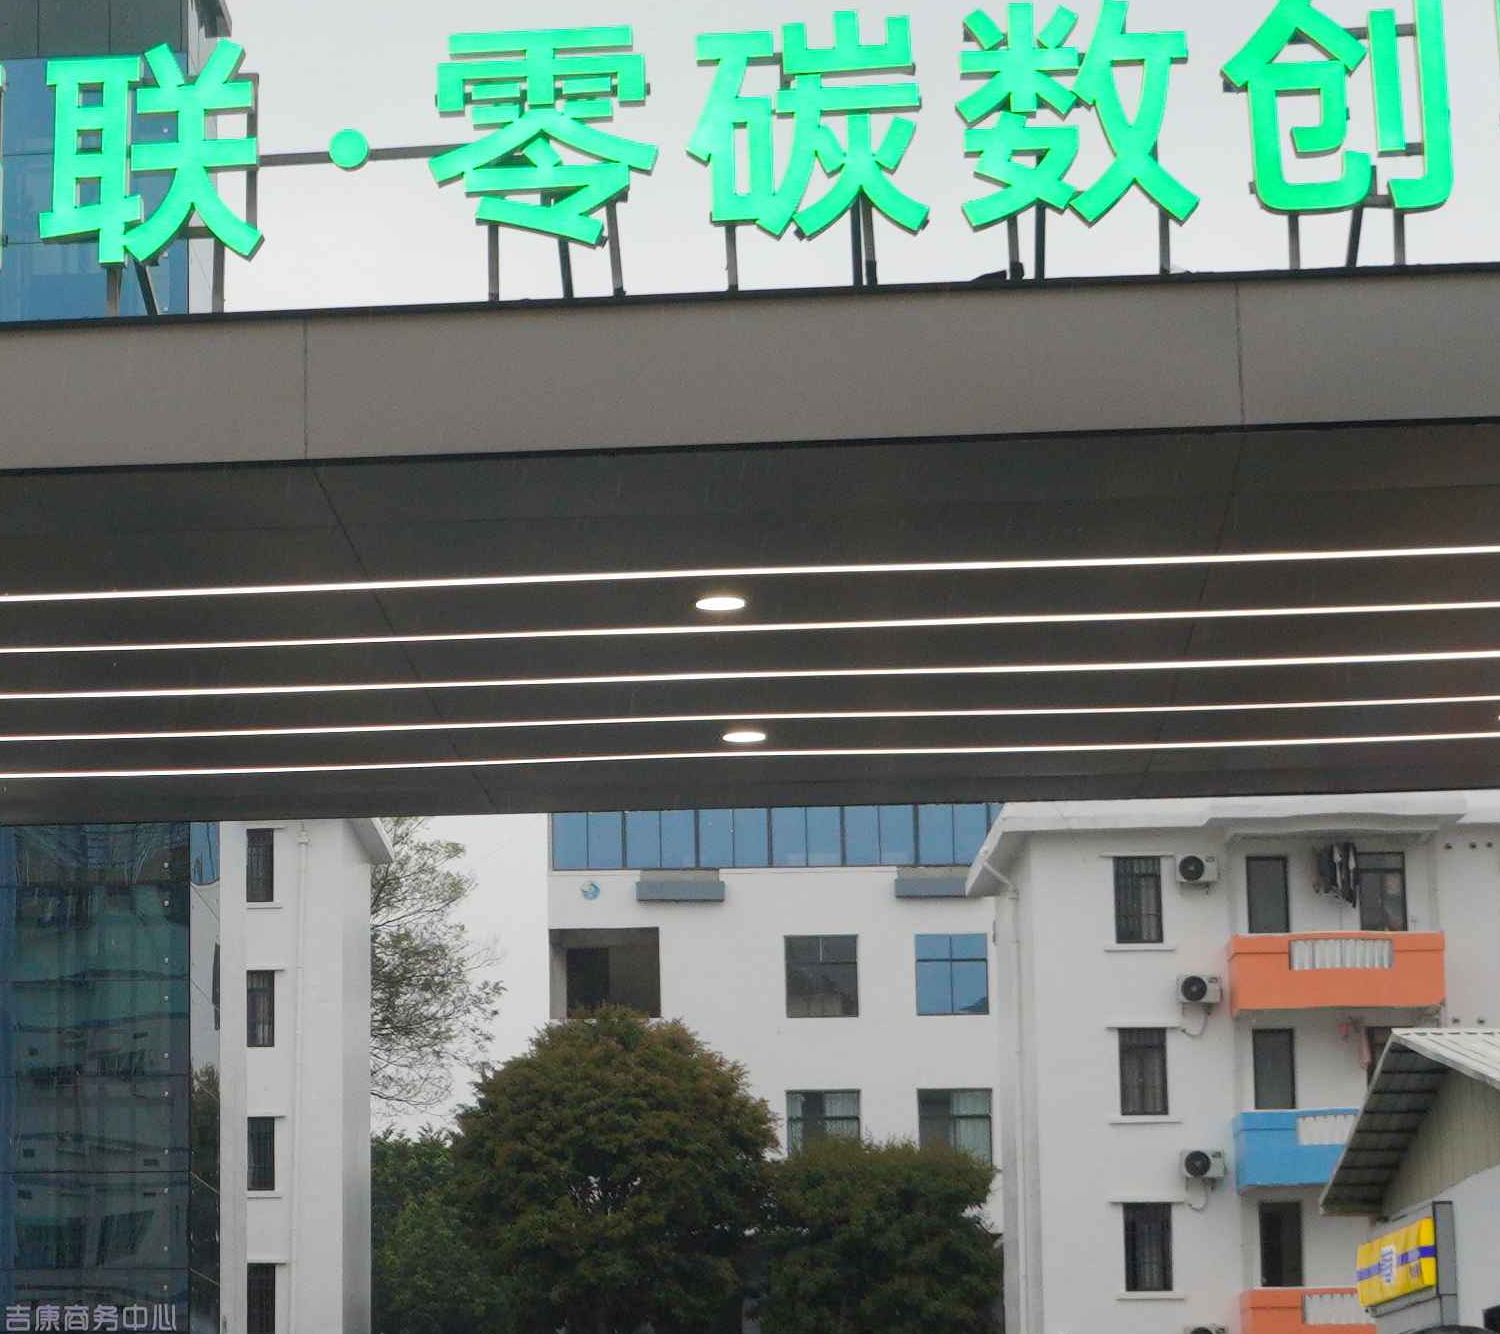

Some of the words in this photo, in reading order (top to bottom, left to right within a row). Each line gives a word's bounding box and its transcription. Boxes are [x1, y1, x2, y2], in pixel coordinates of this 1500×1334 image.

[6, 1304, 177, 1332] 吉康商务中心
